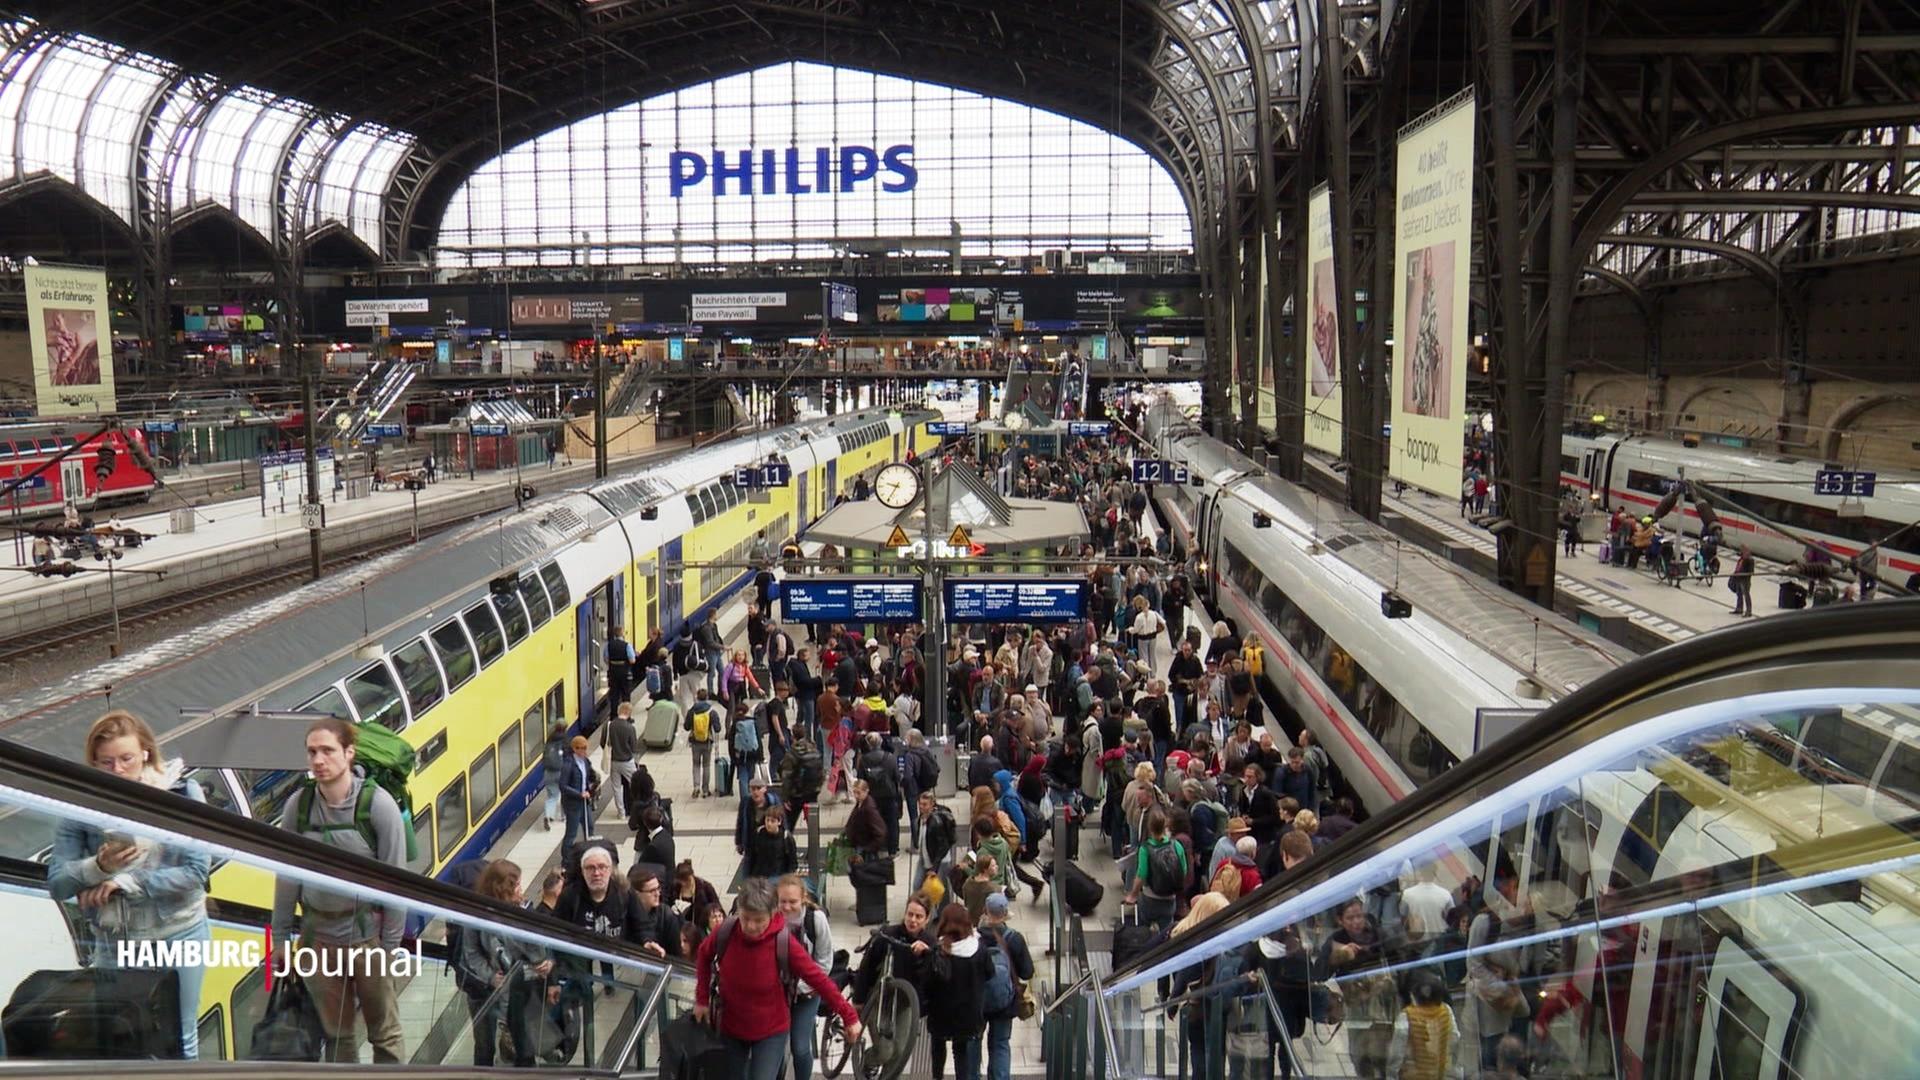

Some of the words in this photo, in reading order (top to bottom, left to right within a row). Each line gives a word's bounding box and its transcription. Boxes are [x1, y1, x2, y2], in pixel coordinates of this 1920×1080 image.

[669, 145, 919, 198] PHILIPS
[41, 290, 52, 300] als
[54, 290, 95, 305] Erfahrung.
[695, 295, 748, 305] Nachrichten
[748, 295, 760, 304] für
[761, 295, 777, 304] alle
[348, 302, 360, 311] Die
[362, 301, 396, 311] Wahrheit
[398, 301, 424, 312] gehört
[349, 315, 363, 324] uns
[695, 311, 717, 319] ohne
[736, 468, 749, 486] E
[761, 467, 783, 486] 11
[1138, 462, 1161, 481] 12
[1174, 467, 1187, 482] E
[1820, 473, 1844, 493] 13
[1851, 474, 1866, 494] E
[301, 504, 321, 516] 286
[307, 517, 315, 527] 6
